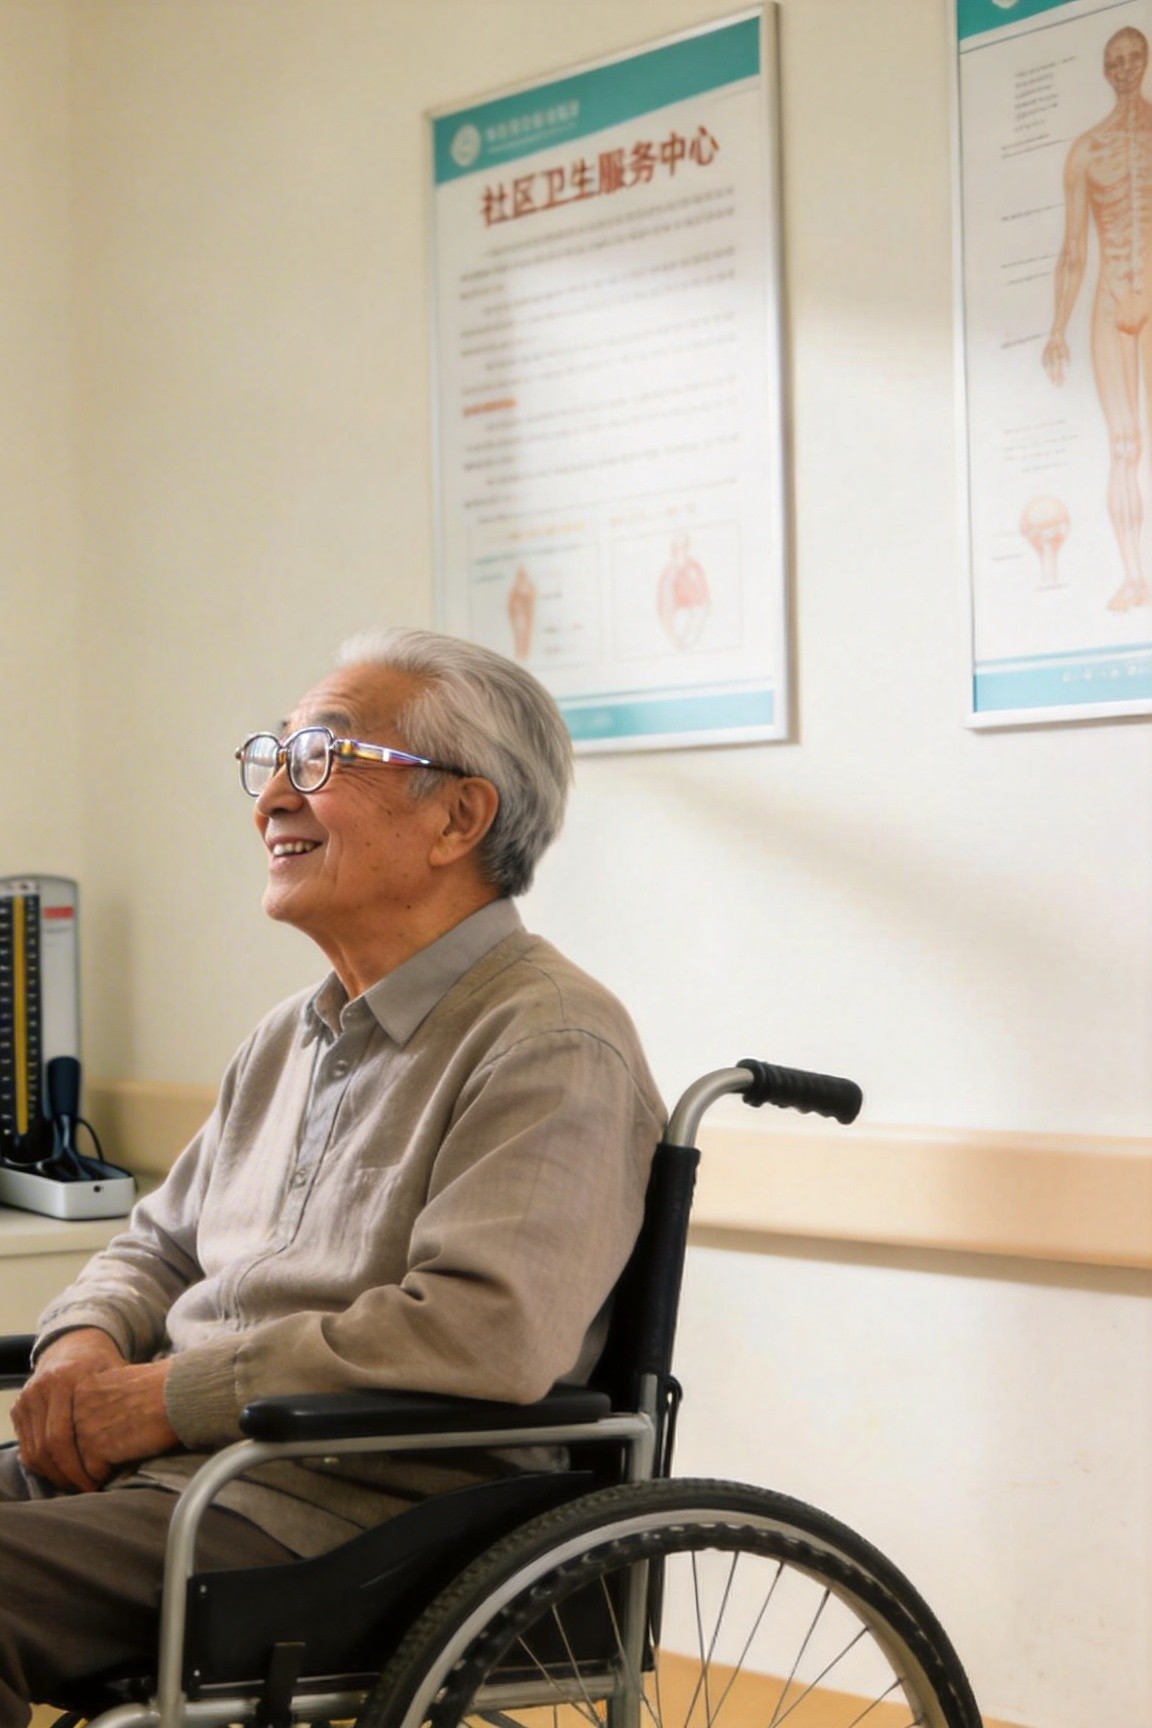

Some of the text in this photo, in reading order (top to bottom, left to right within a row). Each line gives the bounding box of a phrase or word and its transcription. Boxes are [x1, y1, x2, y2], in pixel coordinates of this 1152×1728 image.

[481, 125, 719, 227] 社区卫生服务中心
